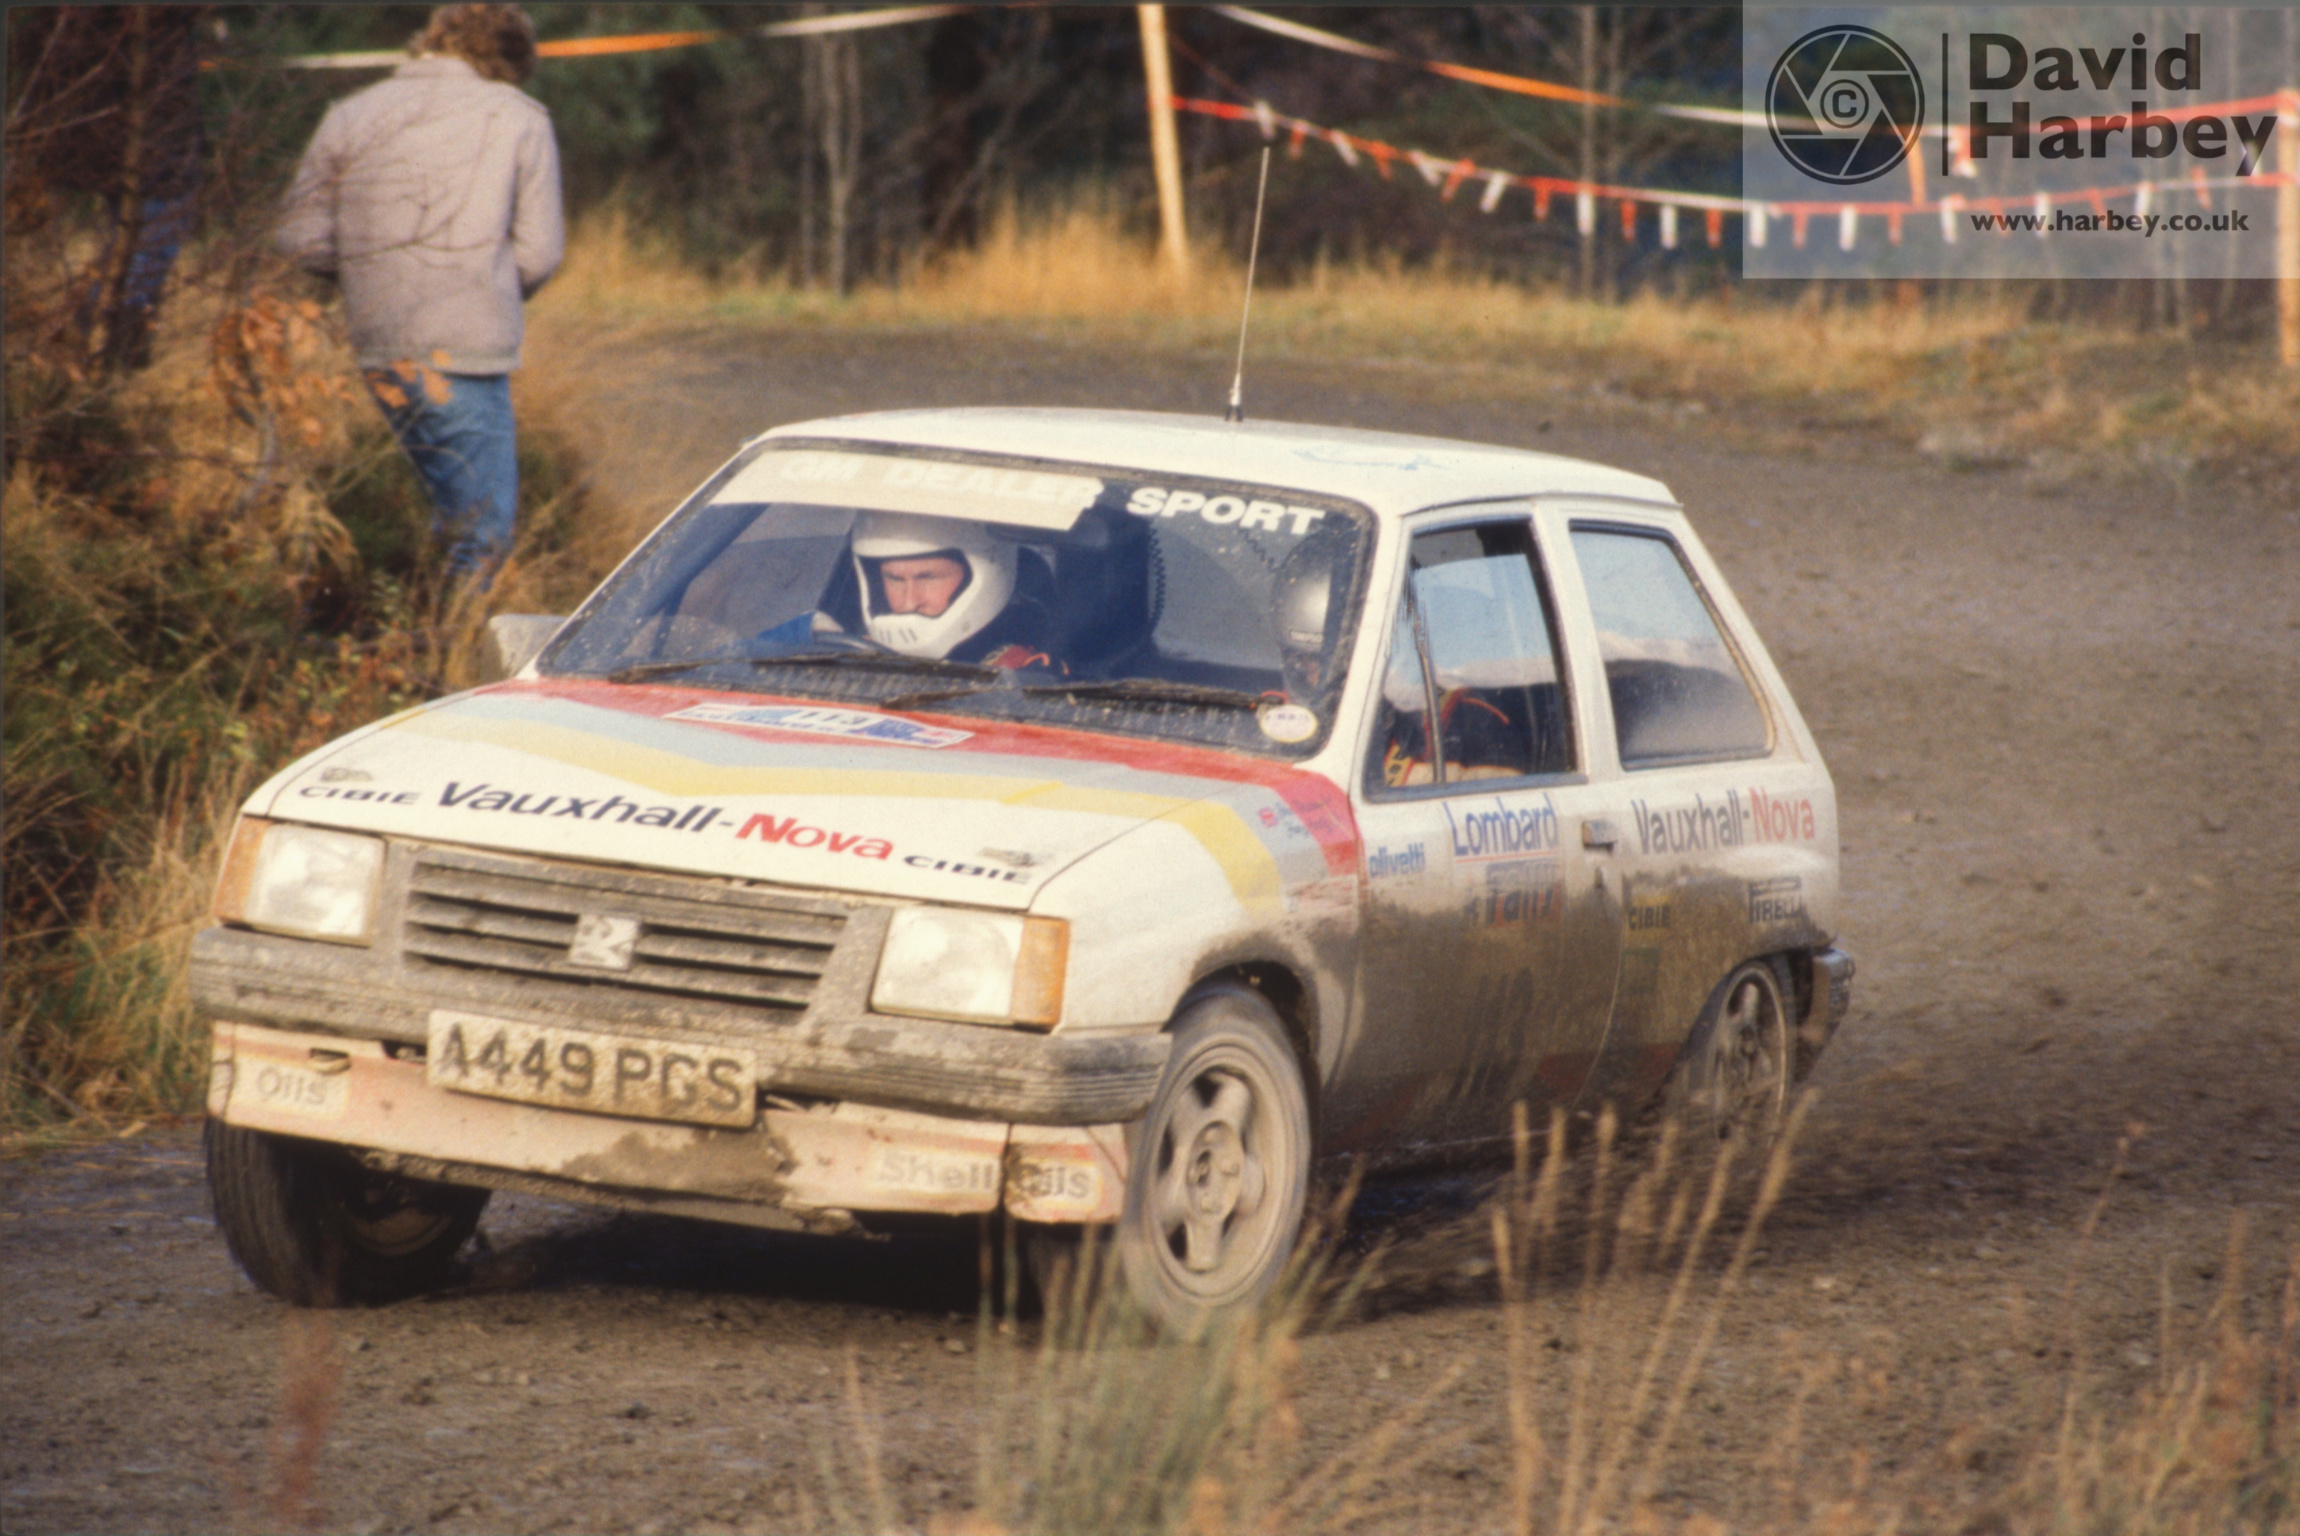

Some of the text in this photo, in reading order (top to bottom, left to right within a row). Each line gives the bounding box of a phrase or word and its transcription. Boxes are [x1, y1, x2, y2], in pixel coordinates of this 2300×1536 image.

[880, 461, 1104, 509] DEALER
[1126, 487, 1326, 535] SPORT
[299, 782, 1034, 884] CIBIE Vauxhall-Nova CIBIE
[1442, 791, 1559, 856] Lombard
[1630, 786, 1815, 854] Vauxhall-Nova
[1369, 842, 1426, 878] olivetti
[442, 1021, 743, 1112] A449 PGS
[877, 1150, 995, 1190] Shell
